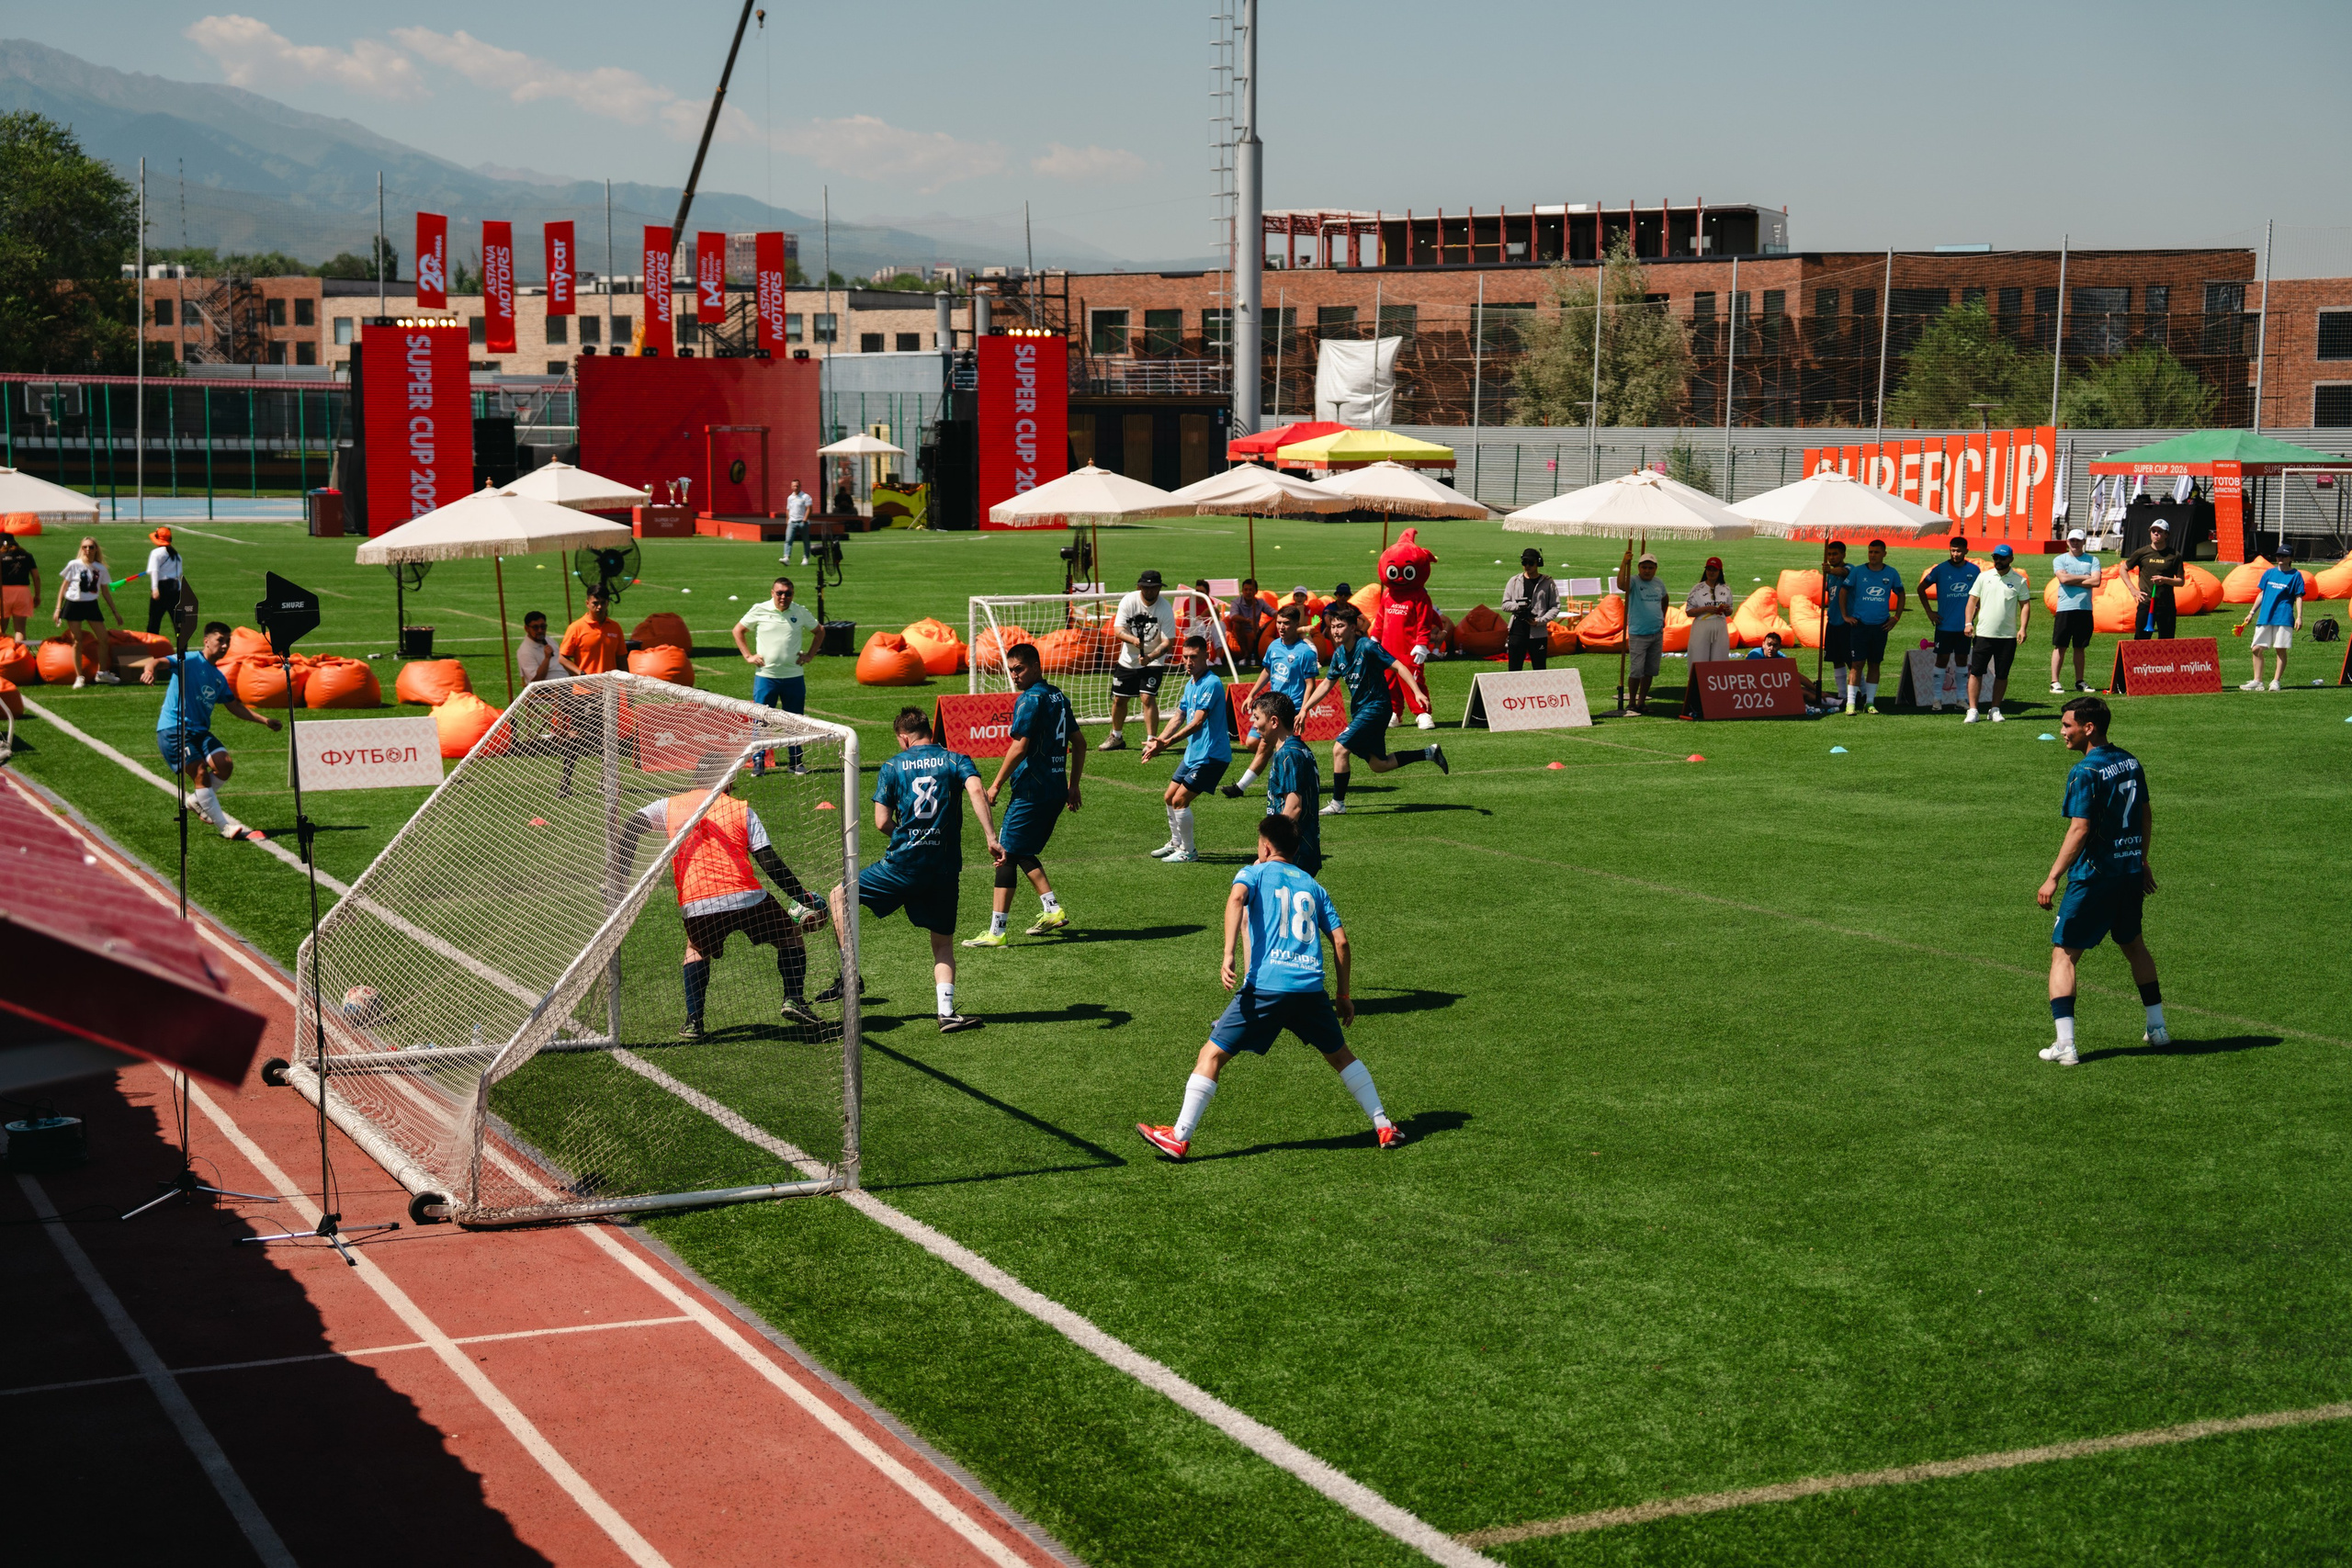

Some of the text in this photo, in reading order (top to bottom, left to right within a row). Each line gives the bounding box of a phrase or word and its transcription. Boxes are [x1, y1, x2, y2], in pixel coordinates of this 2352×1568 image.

[485, 244, 496, 296] ASTANA
[496, 245, 512, 318] MOTORS
[646, 250, 656, 300] ASTANA
[656, 251, 670, 322] MOTORS
[759, 270, 771, 320] ASTANA
[770, 271, 784, 341] MOTORS
[406, 334, 437, 521] SUPER CUP 202
[1014, 344, 1037, 495] SUPER CUP 20
[2133, 464, 2188, 474] SUPER CUP 2026
[2214, 476, 2241, 486] ГОТОВ
[281, 601, 305, 609] SHURE
[1707, 671, 1792, 692] SUPER CUP
[1732, 693, 1774, 709] 2026
[990, 712, 1013, 723] AST
[1056, 707, 1066, 747] 4
[902, 757, 944, 771] UMAROV
[912, 775, 937, 818] 8
[2119, 778, 2137, 829] 7
[908, 828, 941, 838] TOYOTA
[2113, 850, 2142, 859] SUBAR
[1274, 886, 1316, 945] 18
[1270, 959, 1299, 968] Premium
